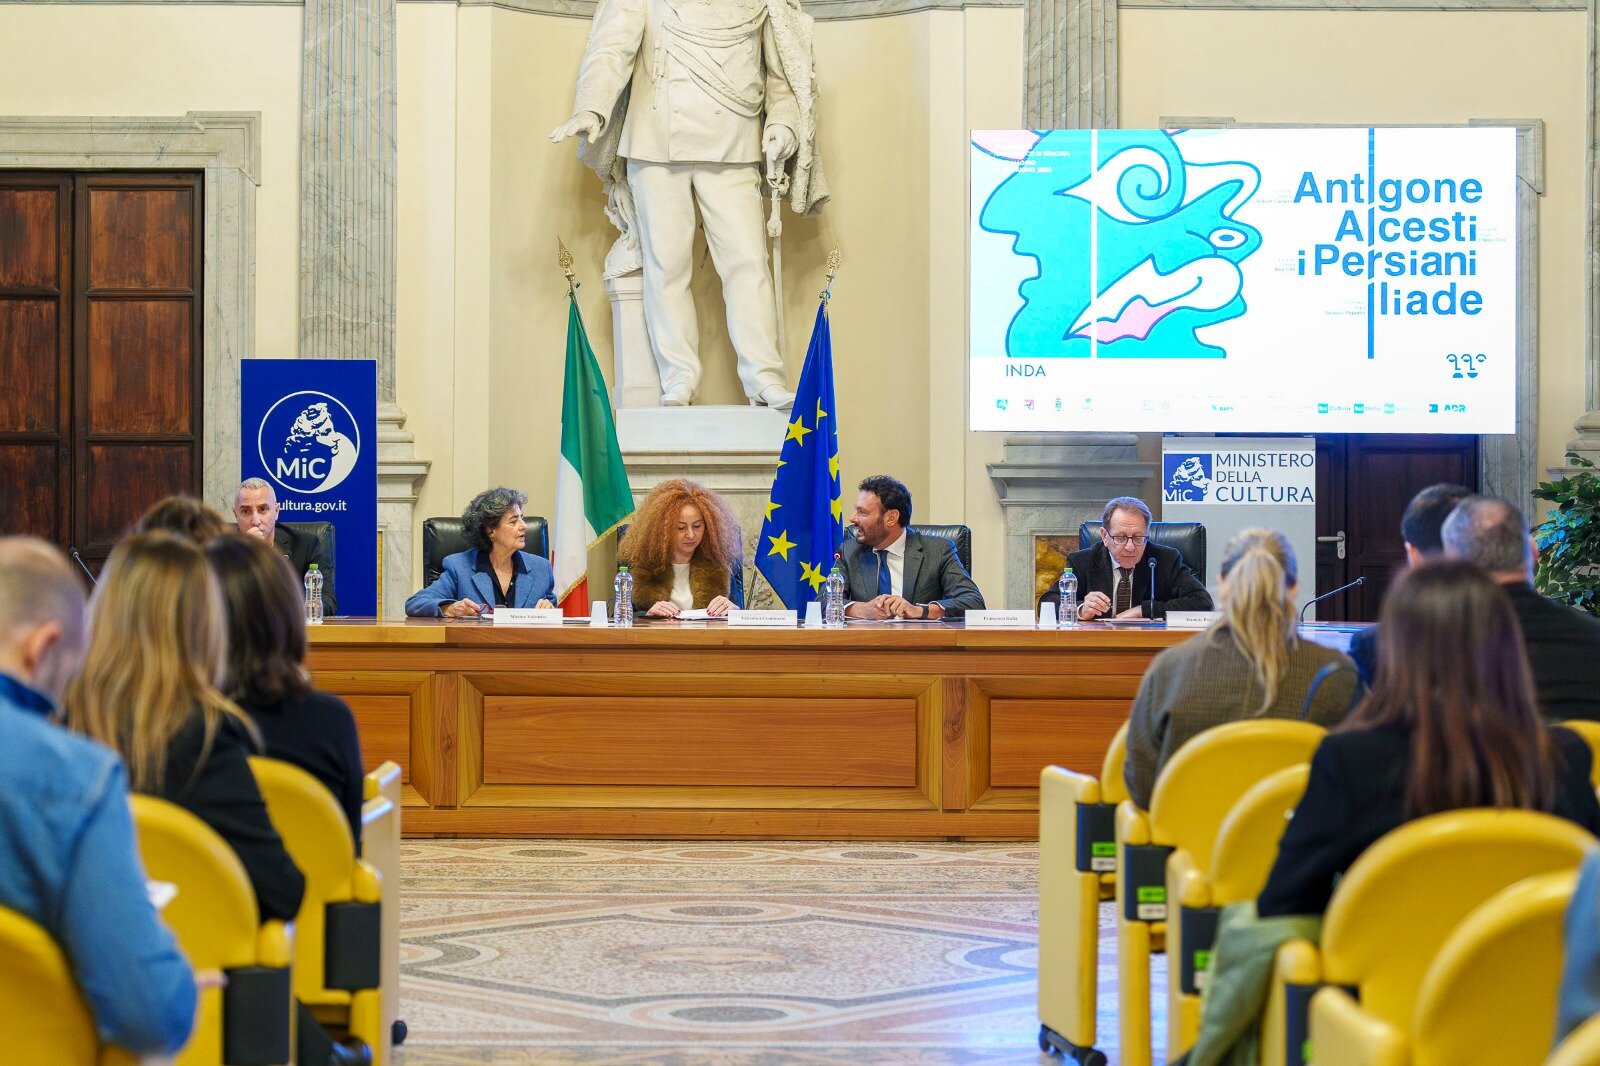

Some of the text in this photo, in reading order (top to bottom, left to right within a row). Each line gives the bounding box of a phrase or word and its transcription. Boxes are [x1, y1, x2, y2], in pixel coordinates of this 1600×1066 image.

[1293, 171, 1483, 212] Antigone
[1335, 207, 1477, 247] Alcesti
[1298, 244, 1477, 279] i Persiani
[1006, 364, 1046, 377] INDA
[276, 457, 326, 479] MiC
[1216, 453, 1314, 467] MINISTERO
[1216, 471, 1262, 483] DELLA
[1165, 489, 1193, 501] MiC
[1216, 486, 1315, 502] CULTURA
